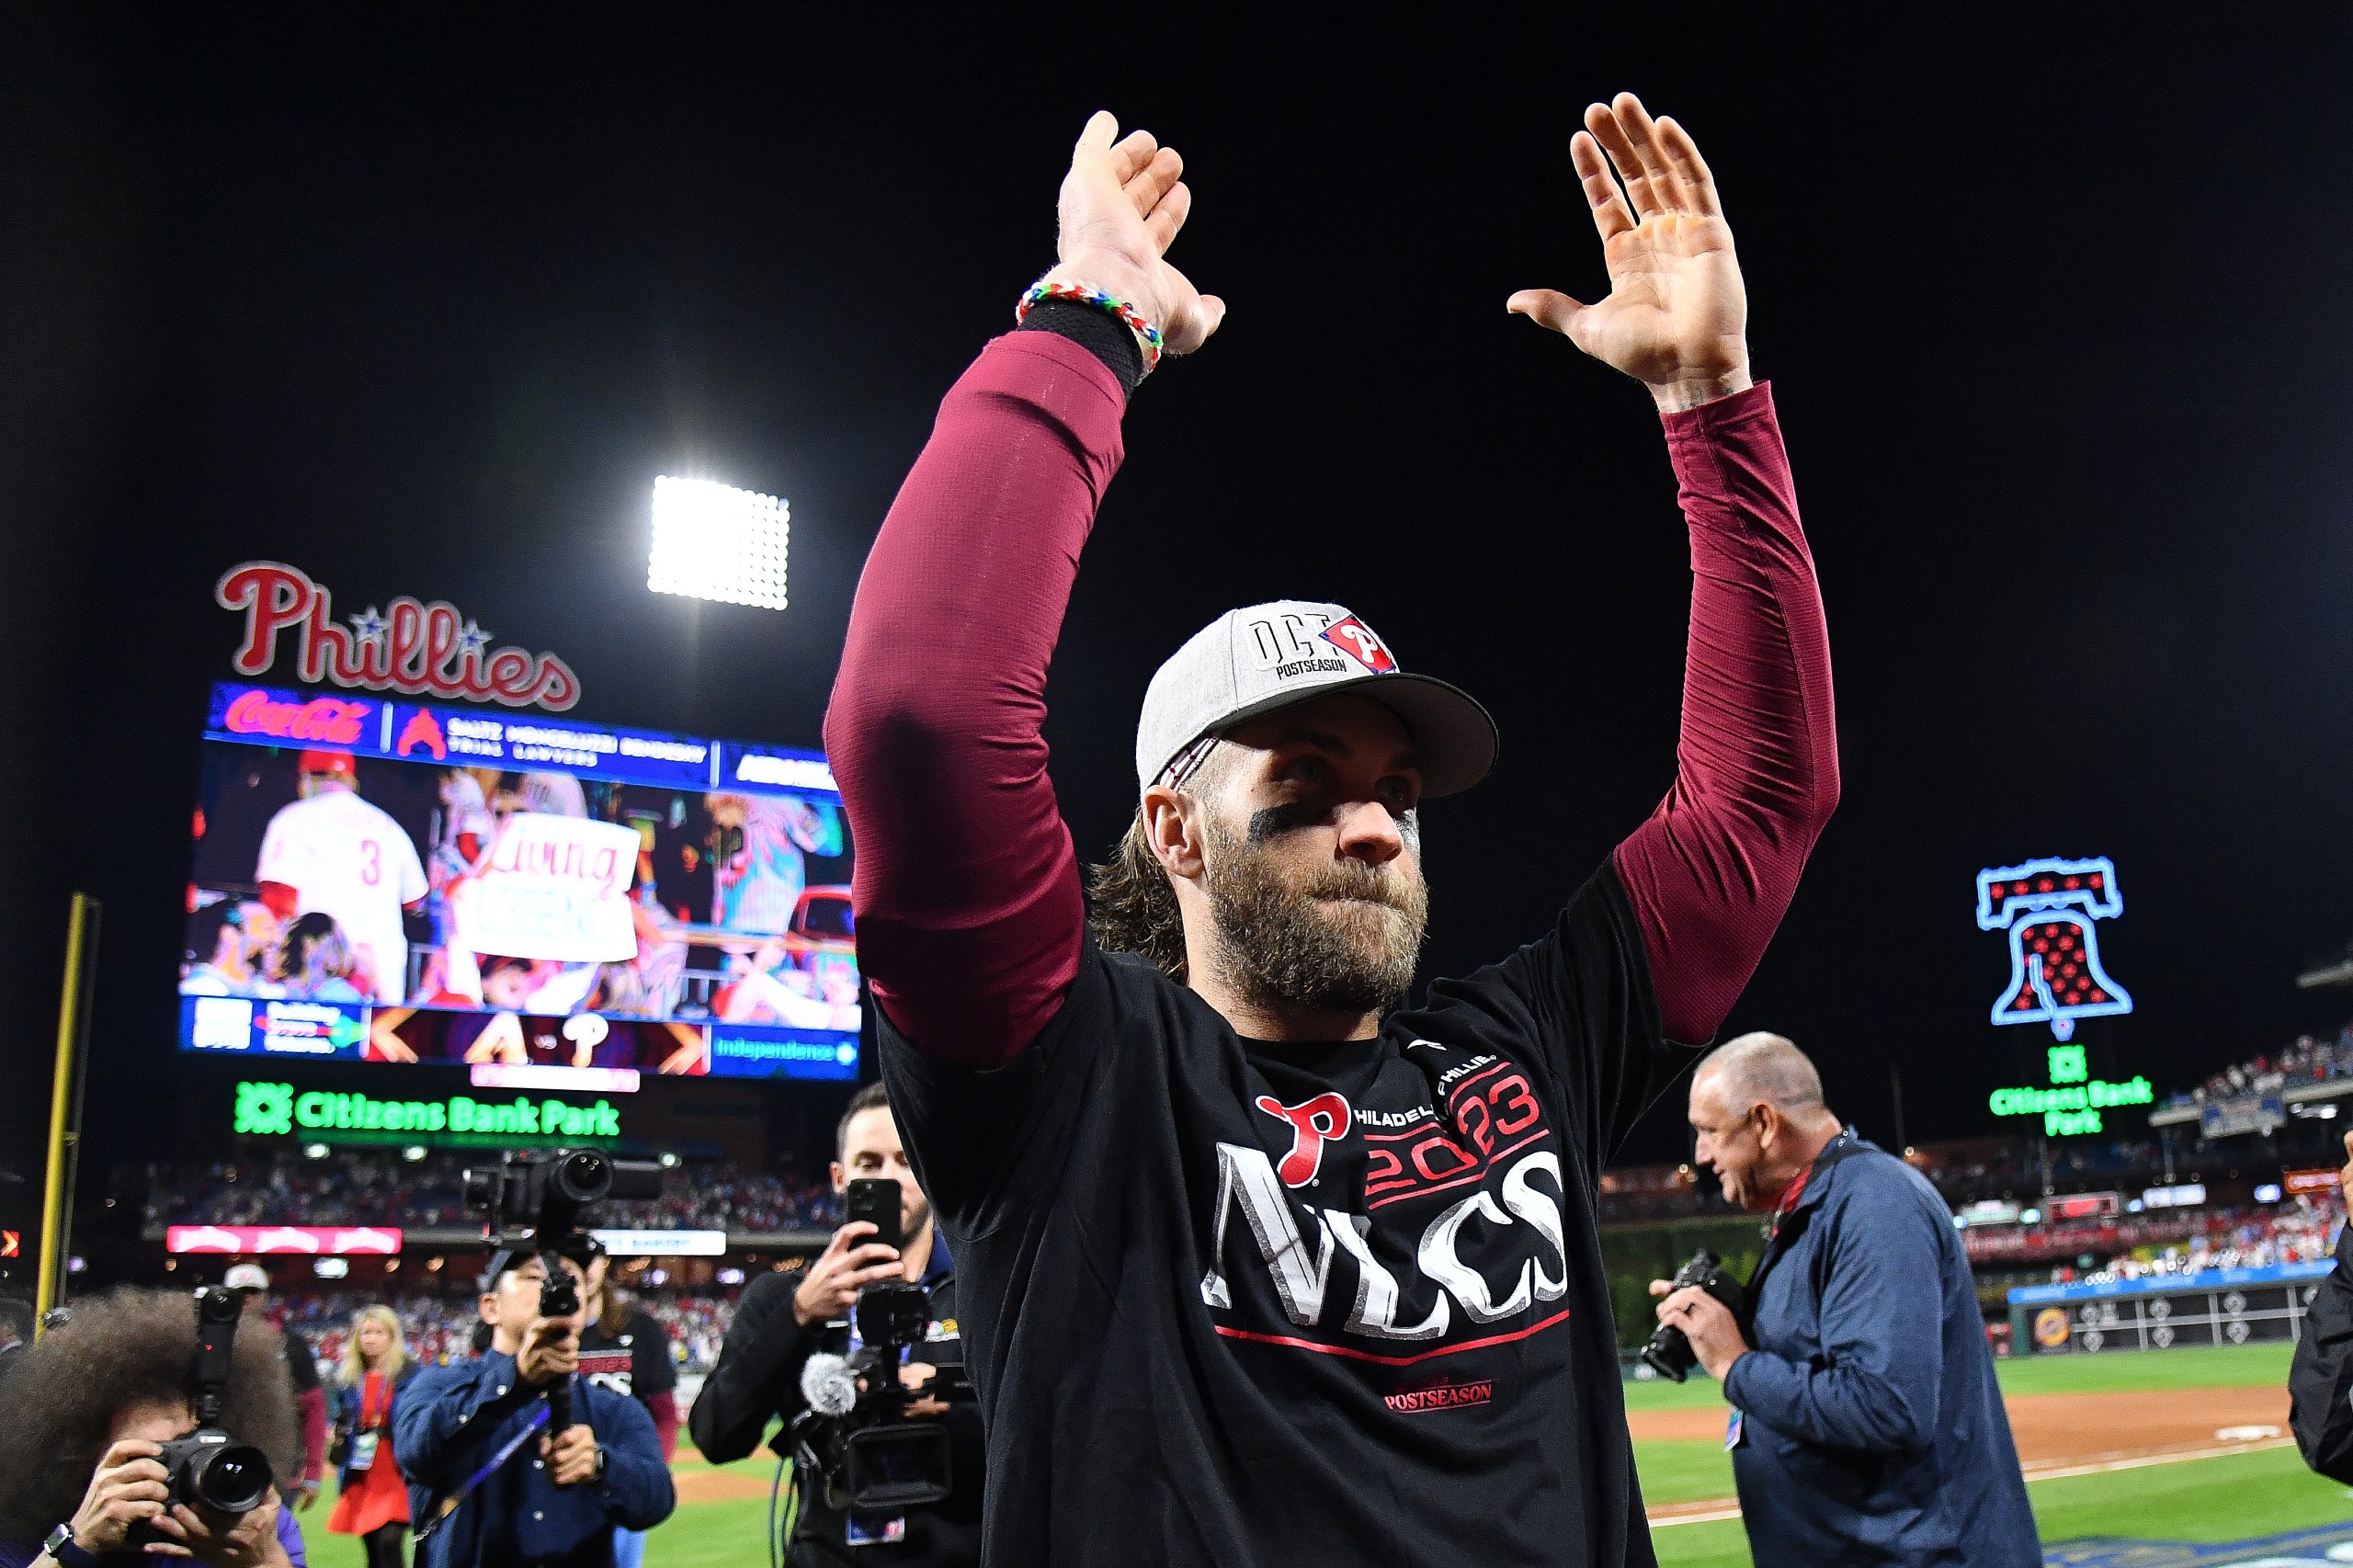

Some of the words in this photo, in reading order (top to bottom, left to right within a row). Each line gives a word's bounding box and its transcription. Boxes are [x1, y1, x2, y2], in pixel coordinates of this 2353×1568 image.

[215, 561, 581, 711] Phillies
[1277, 659, 1347, 680] POSTSEASON
[359, 839, 381, 886] 3
[295, 1091, 446, 1131] Citizens
[449, 1096, 540, 1133] Bank
[541, 1100, 620, 1136] Park
[1365, 1074, 1540, 1196] 2023
[1200, 1142, 1568, 1340] NLCS
[1384, 1384, 1492, 1411] POSTSEASON
